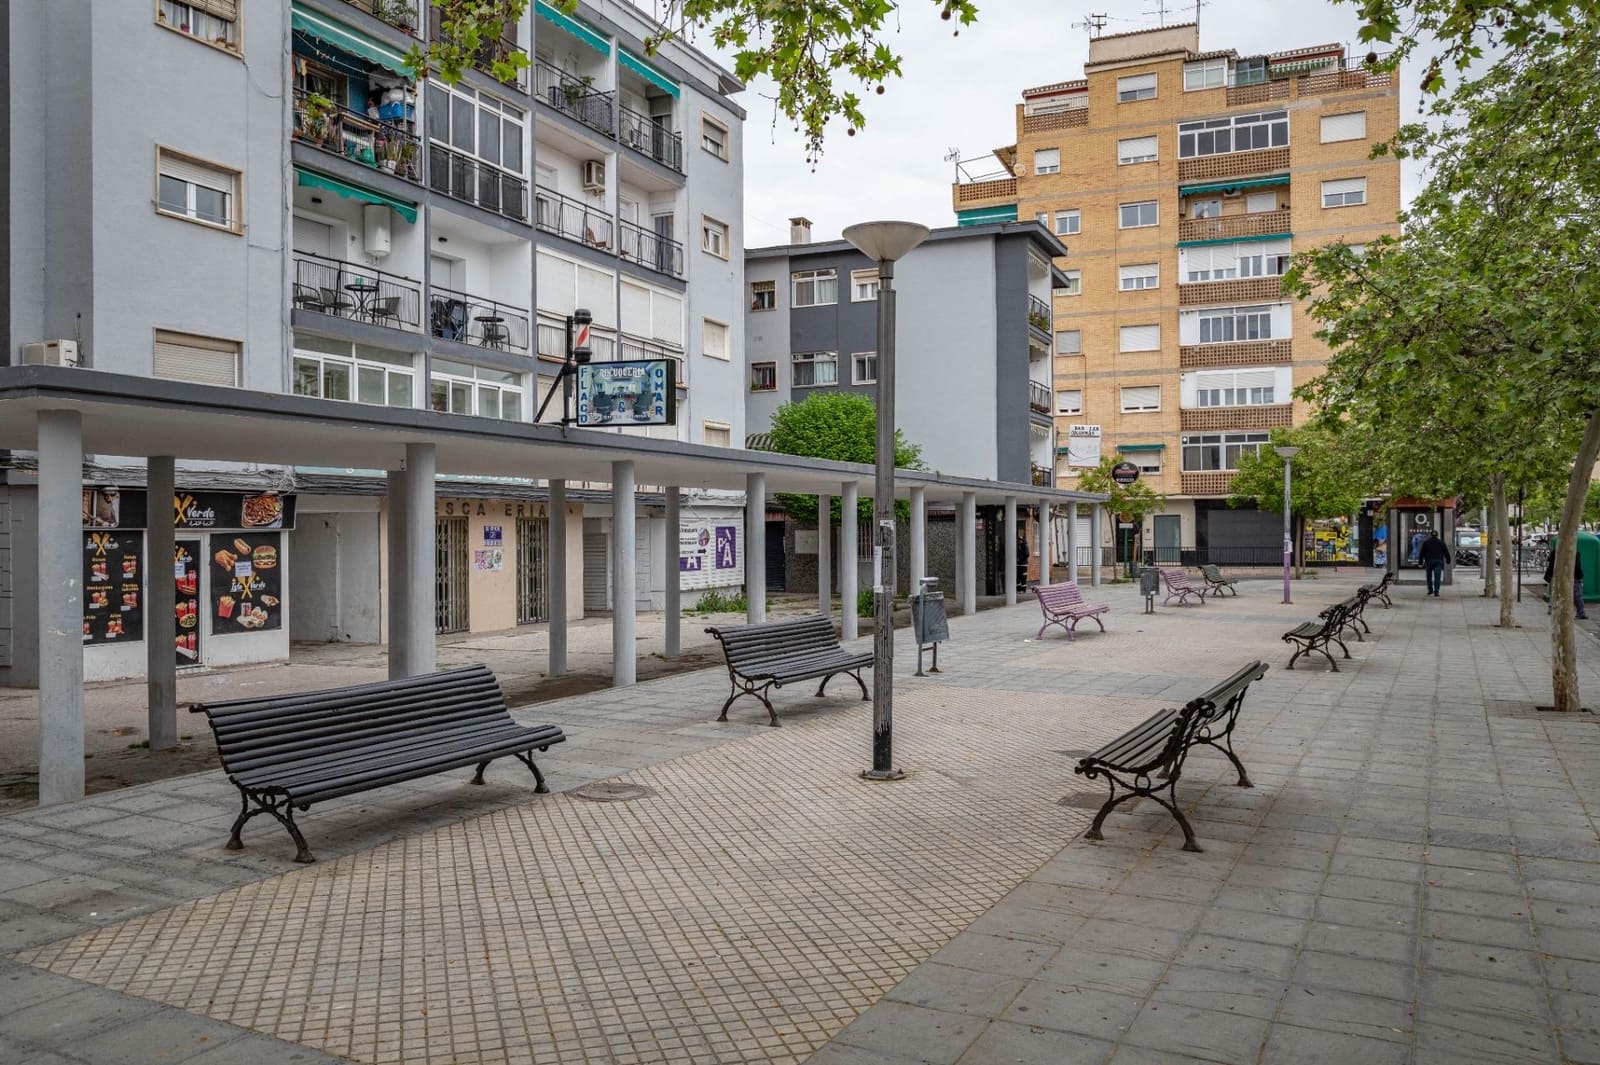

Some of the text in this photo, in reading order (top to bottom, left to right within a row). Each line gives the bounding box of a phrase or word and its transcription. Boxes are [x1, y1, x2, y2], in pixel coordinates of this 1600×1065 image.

[580, 367, 588, 423] FLACO
[654, 368, 664, 416] OMAR
[187, 504, 215, 518] Verde
